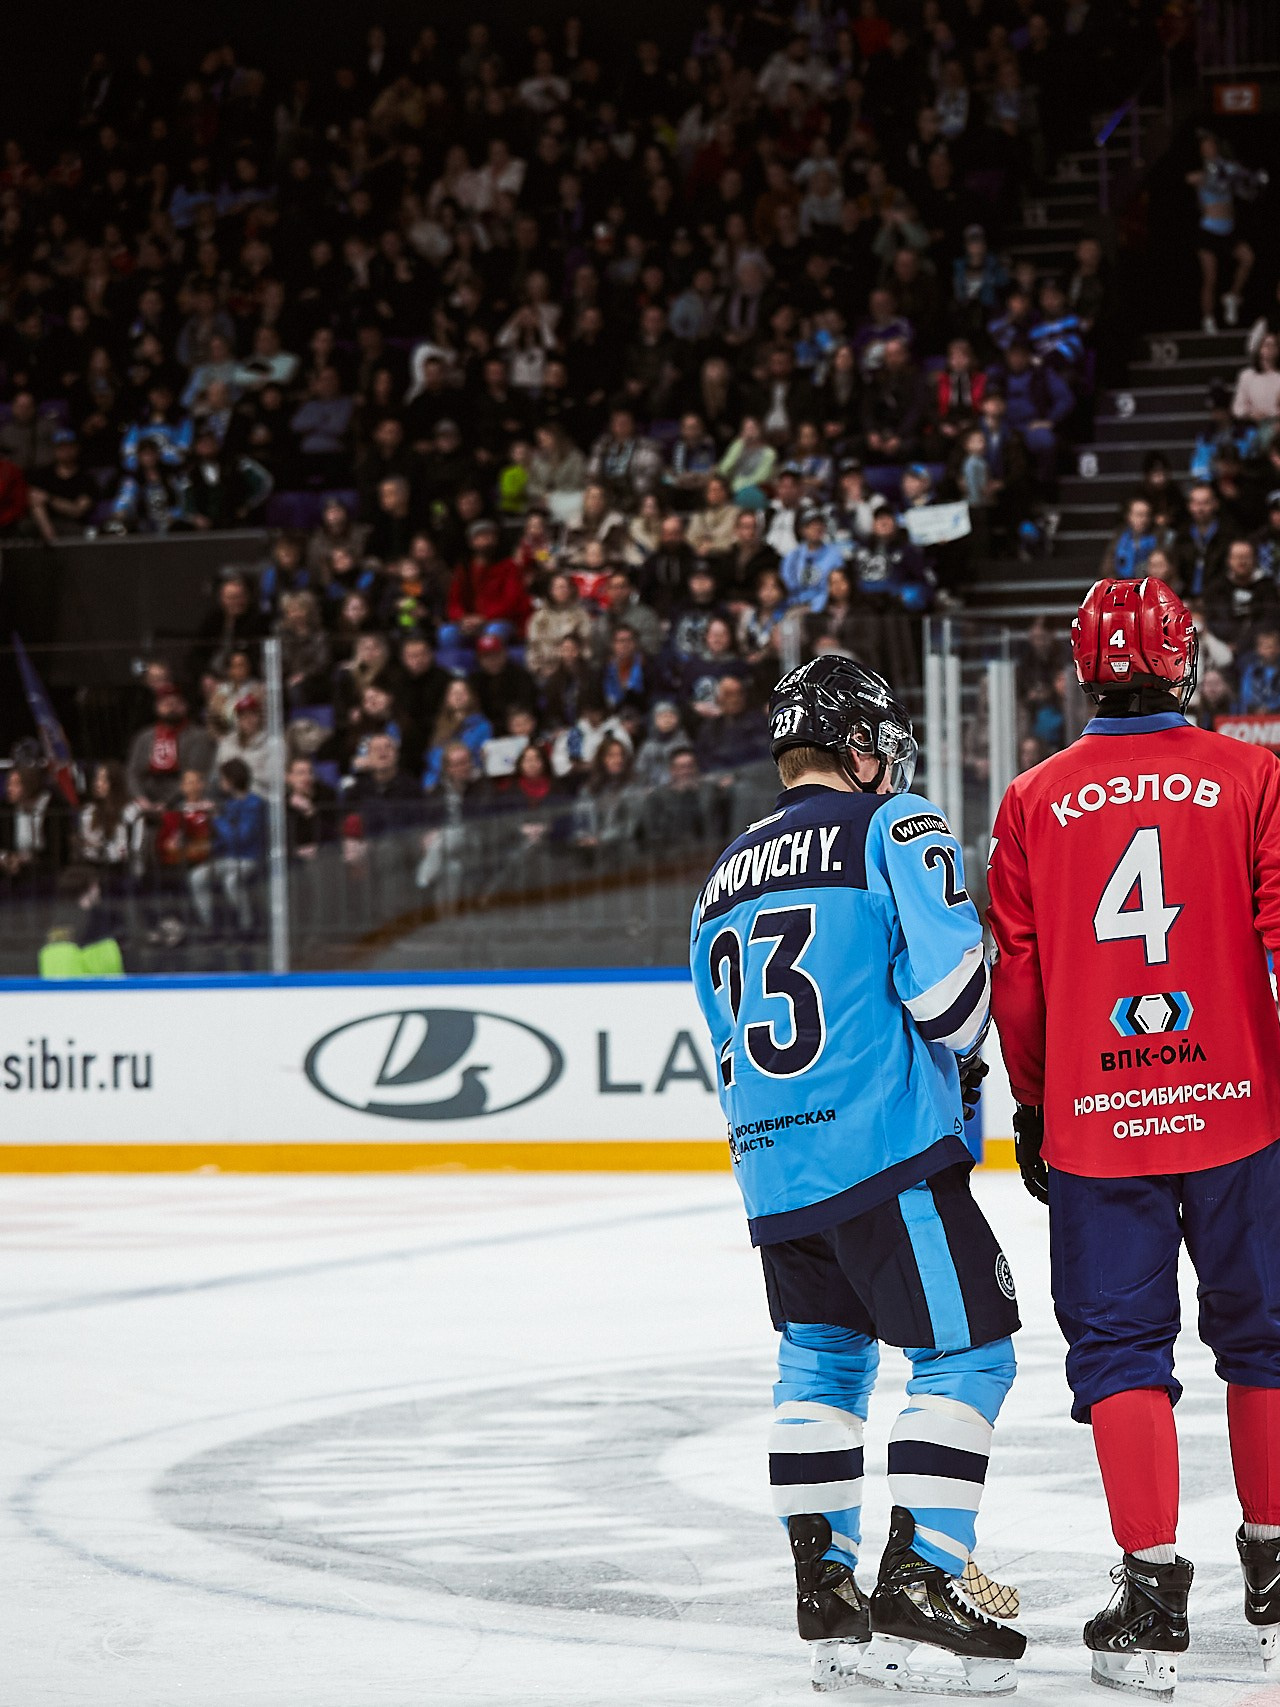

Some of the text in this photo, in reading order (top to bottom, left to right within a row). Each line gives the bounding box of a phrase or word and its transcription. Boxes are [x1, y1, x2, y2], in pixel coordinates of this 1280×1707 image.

[1116, 392, 1135, 418] 9
[1109, 629, 1126, 648] 4
[774, 708, 793, 739] 23
[1051, 774, 1221, 827] КОЗЛОВ
[819, 825, 842, 872] Y.
[1092, 825, 1185, 966] 4
[709, 903, 827, 1091] 23
[1101, 1038, 1207, 1072] ВПК-ОЙЛ
[1074, 1079, 1251, 1117] НОВОСИБИРСКАЯ
[1113, 1113, 1206, 1139] ОБЛАСТЬ
